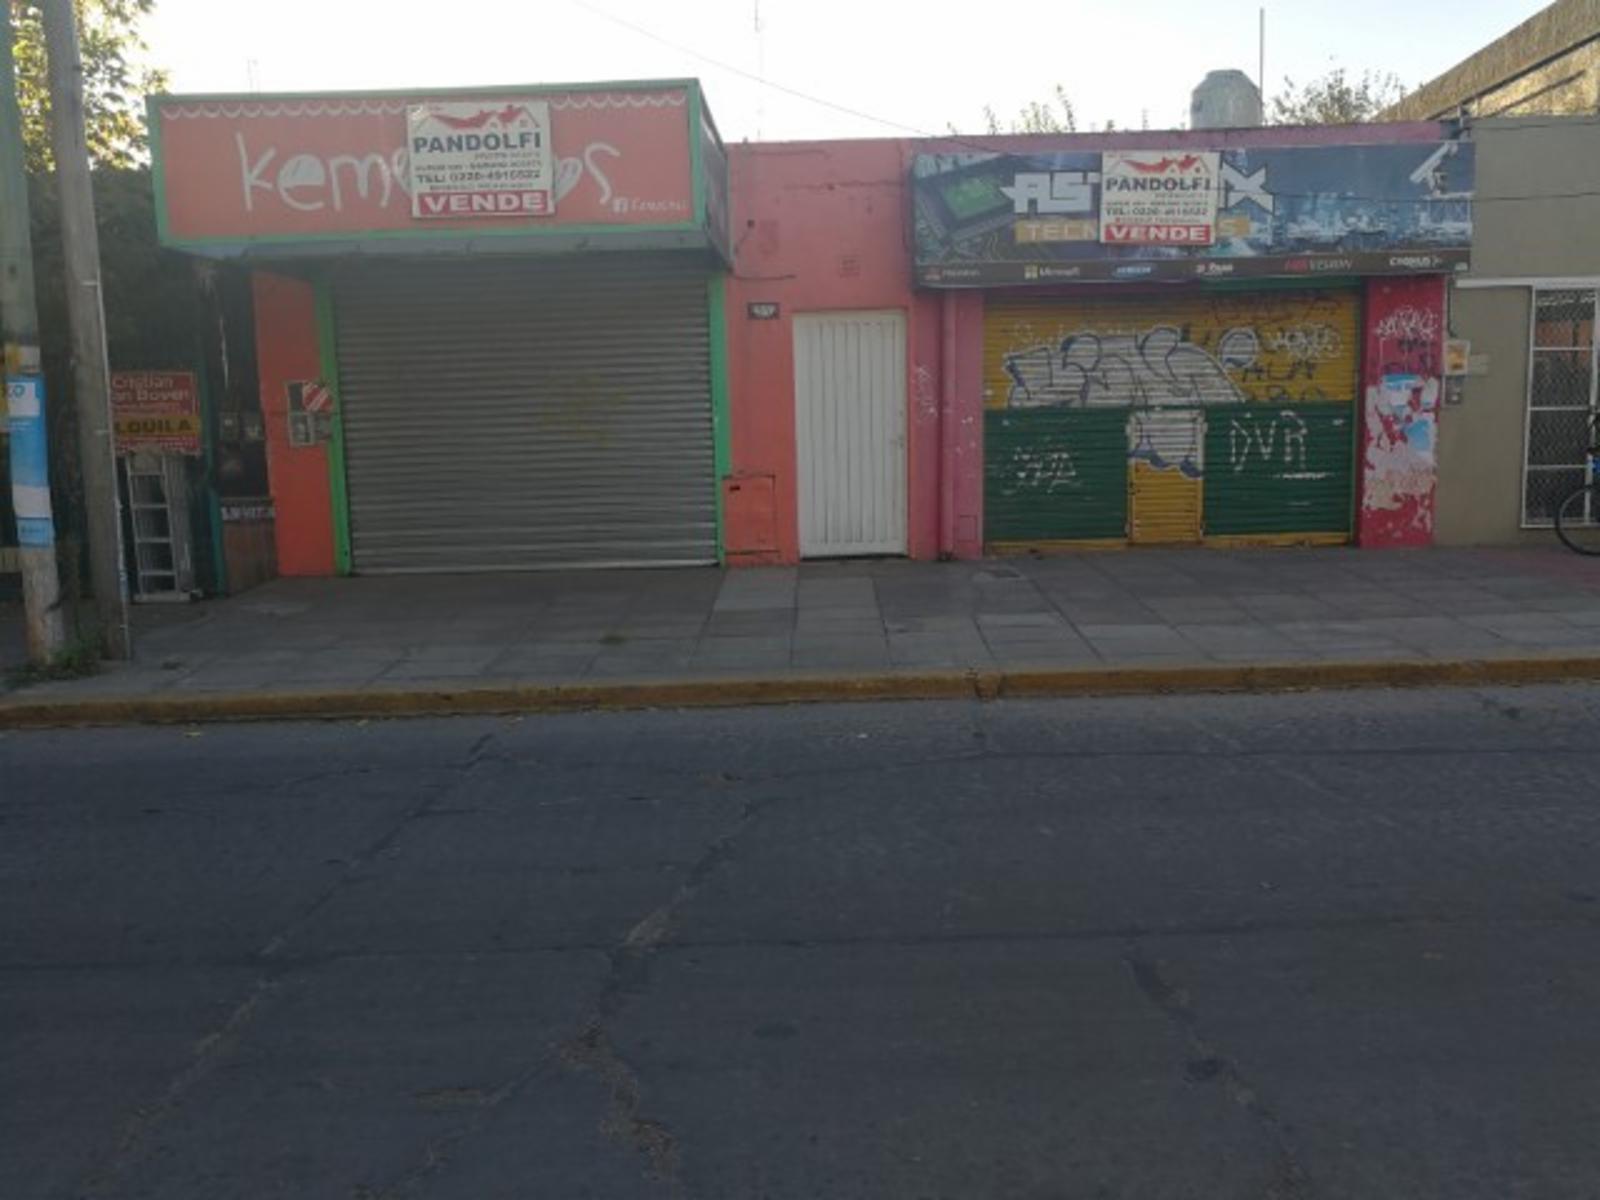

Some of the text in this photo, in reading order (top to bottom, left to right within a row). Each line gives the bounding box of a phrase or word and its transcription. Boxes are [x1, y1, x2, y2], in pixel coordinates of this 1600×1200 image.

[413, 131, 541, 154] PANDOLFI
[1105, 176, 1211, 191] PANDOLFI
[423, 191, 546, 213] VENDE
[1109, 225, 1207, 241] VENDE
[114, 418, 192, 434] LQUILA
[1230, 409, 1308, 471] DVR
